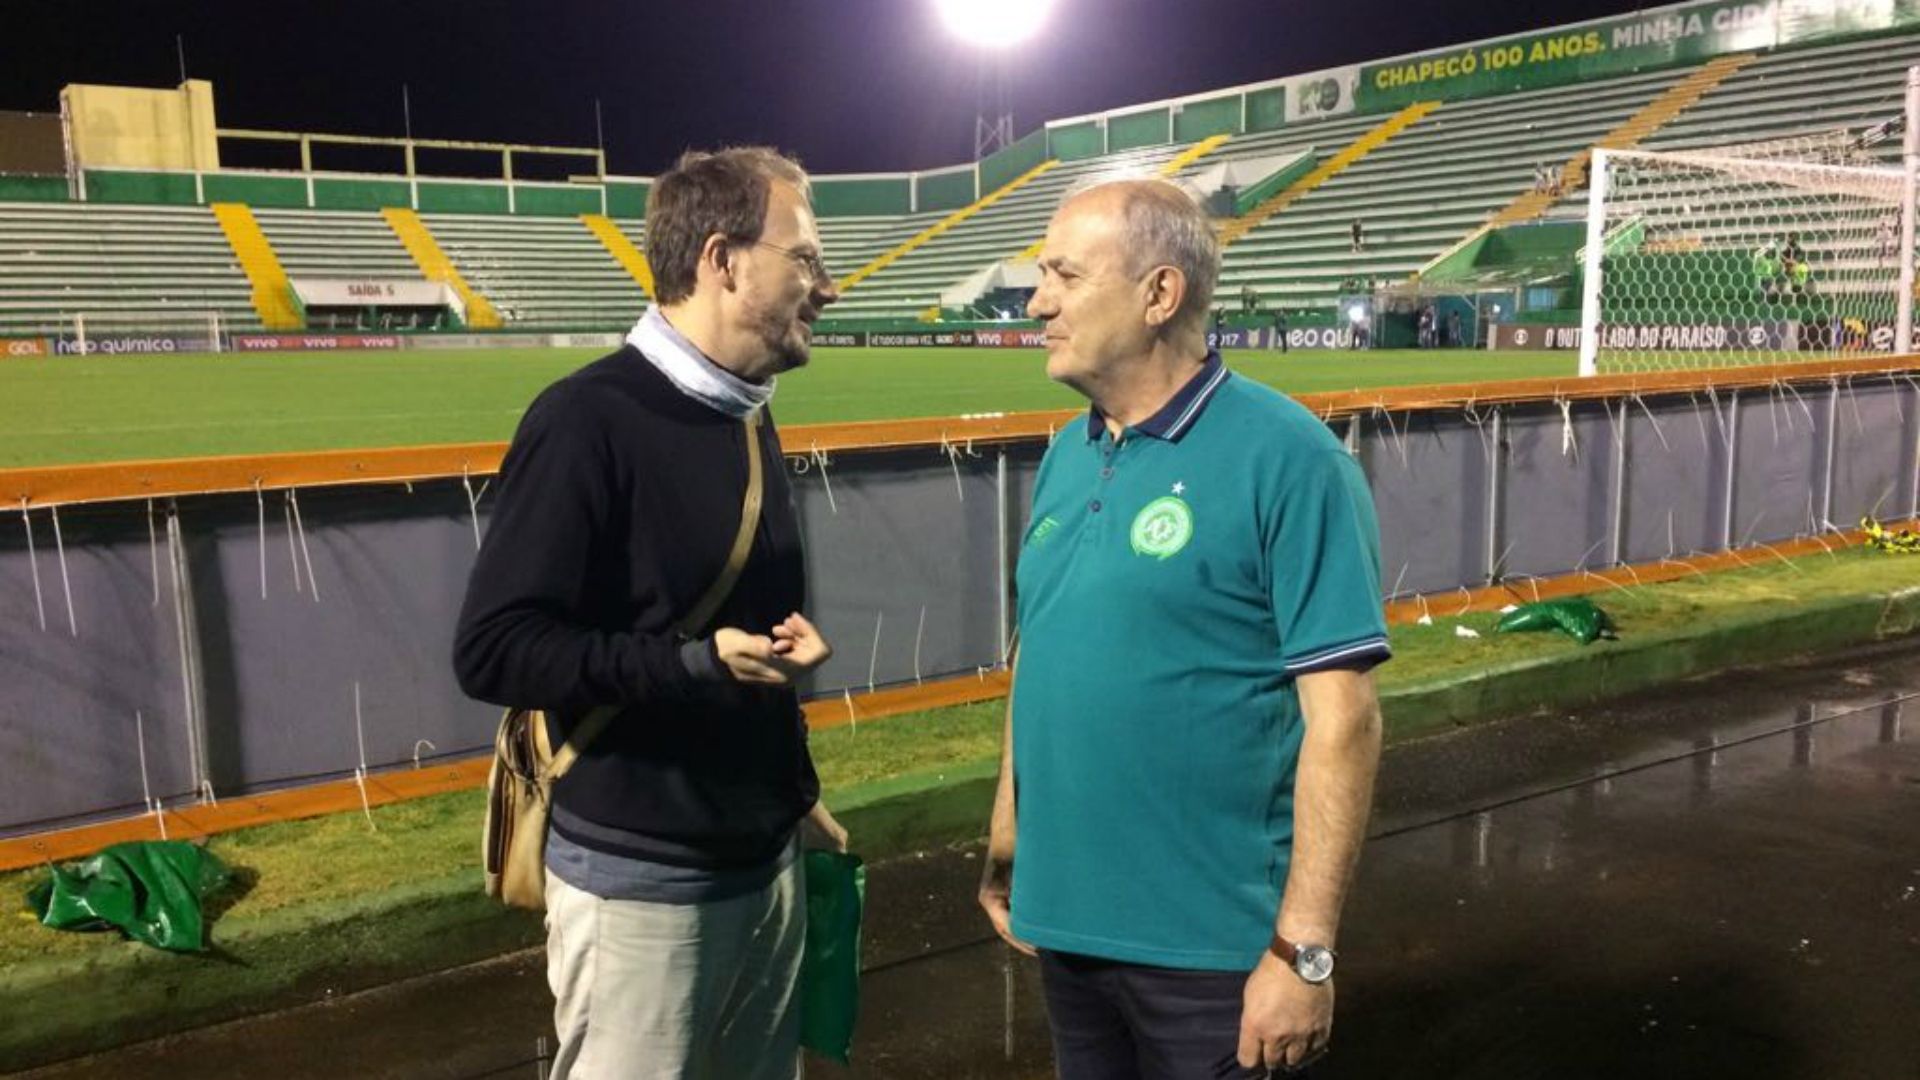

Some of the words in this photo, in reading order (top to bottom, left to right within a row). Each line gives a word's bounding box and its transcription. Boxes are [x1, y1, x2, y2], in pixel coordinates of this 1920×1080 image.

[1375, 48, 1477, 88] CHAPECÓ
[1482, 46, 1524, 70] 100
[1528, 31, 1606, 63] ANOS.
[1612, 13, 1704, 48] MINHA
[243, 338, 279, 348] vivo
[303, 338, 337, 348] vivo
[361, 338, 394, 347] vivo
[1640, 327, 1659, 348] DO
[8, 341, 42, 355] GOL
